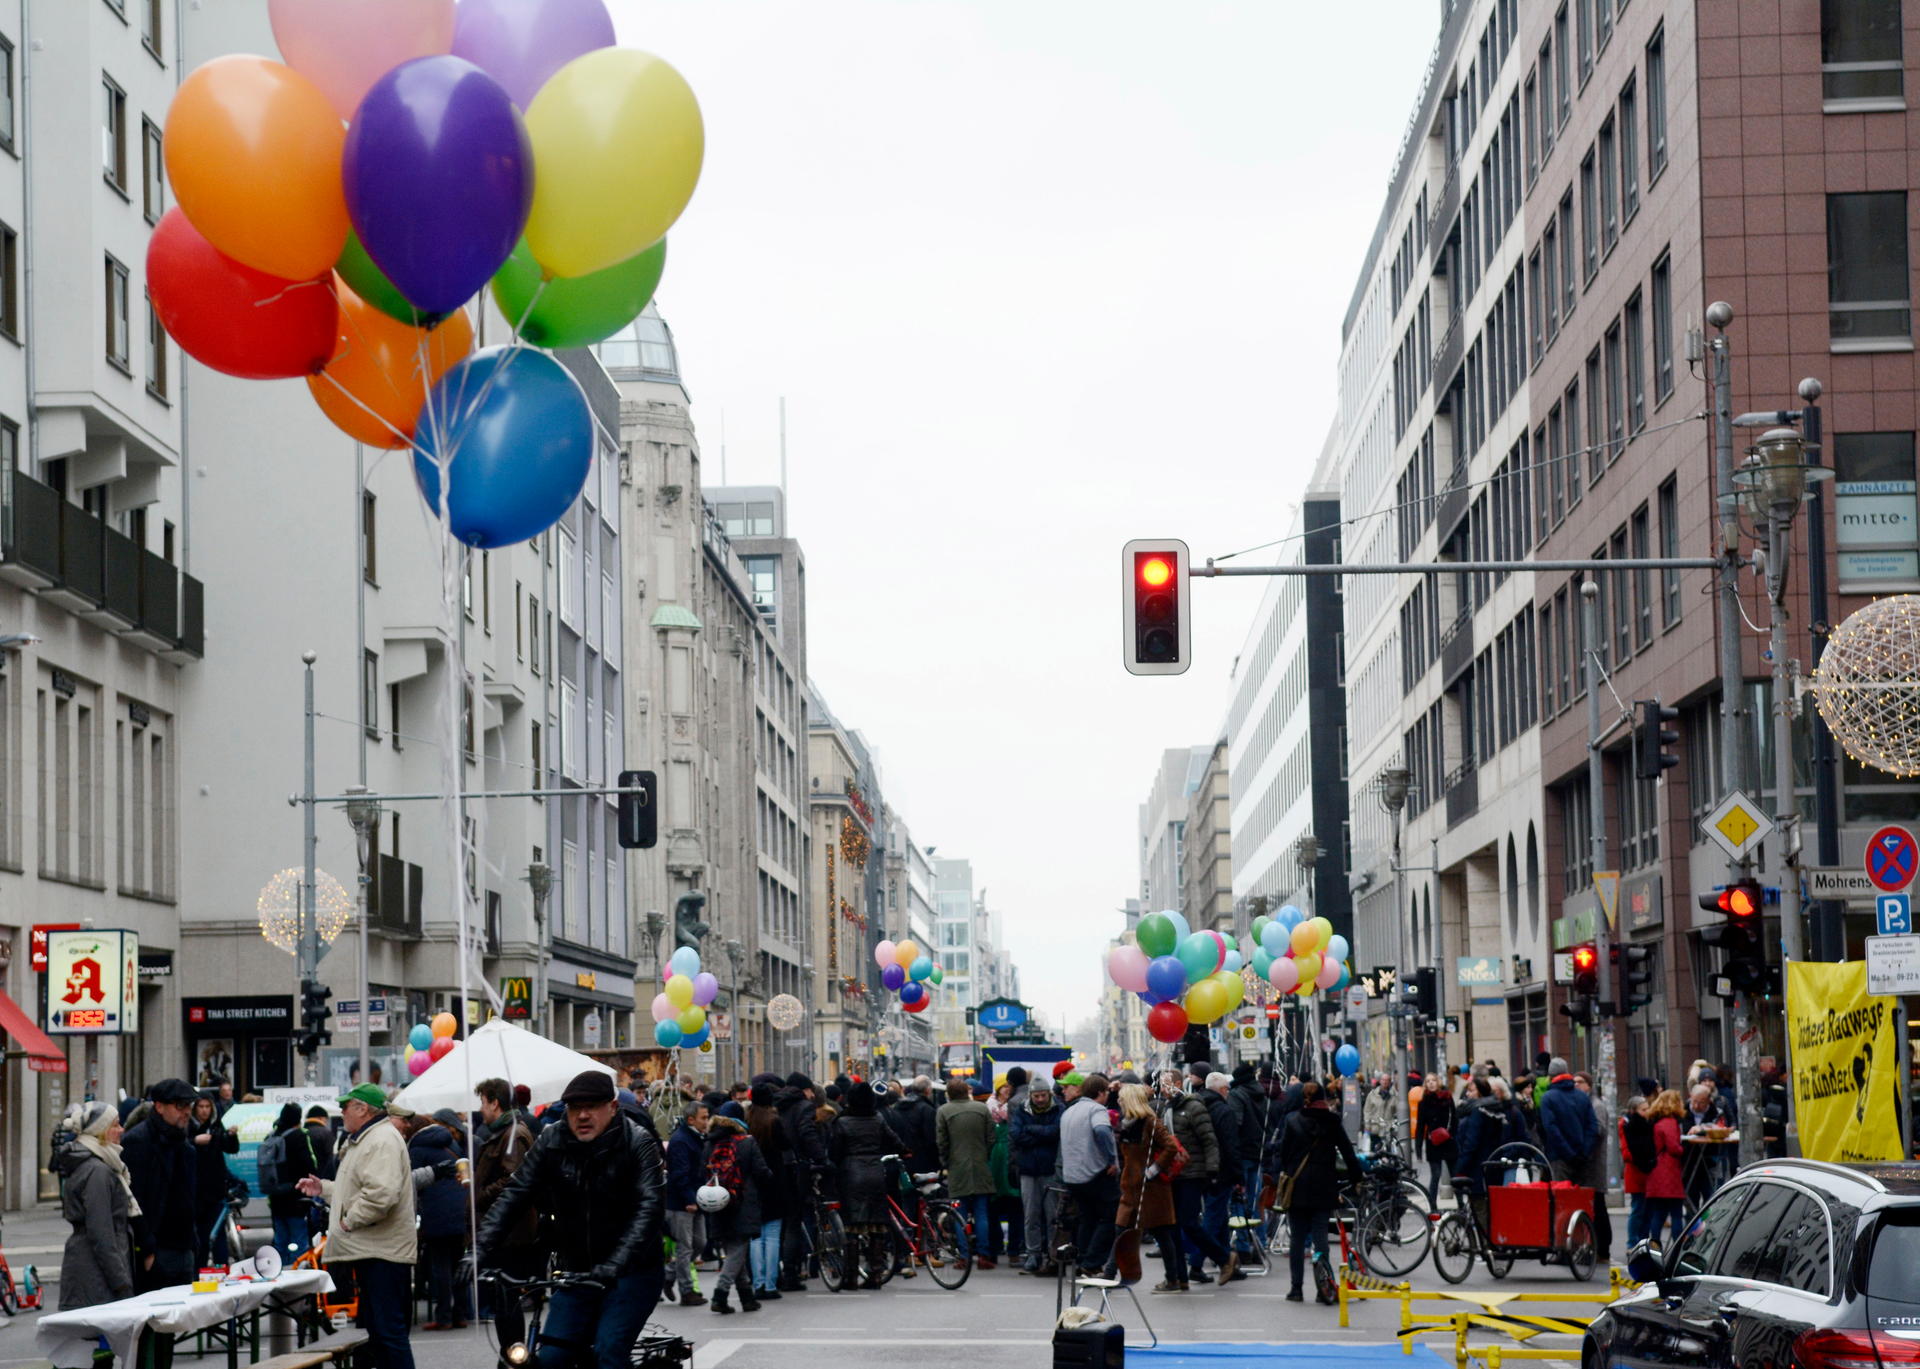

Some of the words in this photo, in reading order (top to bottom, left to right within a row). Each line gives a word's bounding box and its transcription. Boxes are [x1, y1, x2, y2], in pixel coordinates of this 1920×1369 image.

[1815, 873, 1873, 889] Mohrens
[1458, 967, 1500, 982] Shoes!
[208, 1009, 225, 1019] THAI
[226, 1008, 254, 1018] STREET
[255, 1007, 287, 1018] KITCHEN
[996, 1006, 1008, 1020] U
[1812, 1061, 1856, 1100] Kinder!
